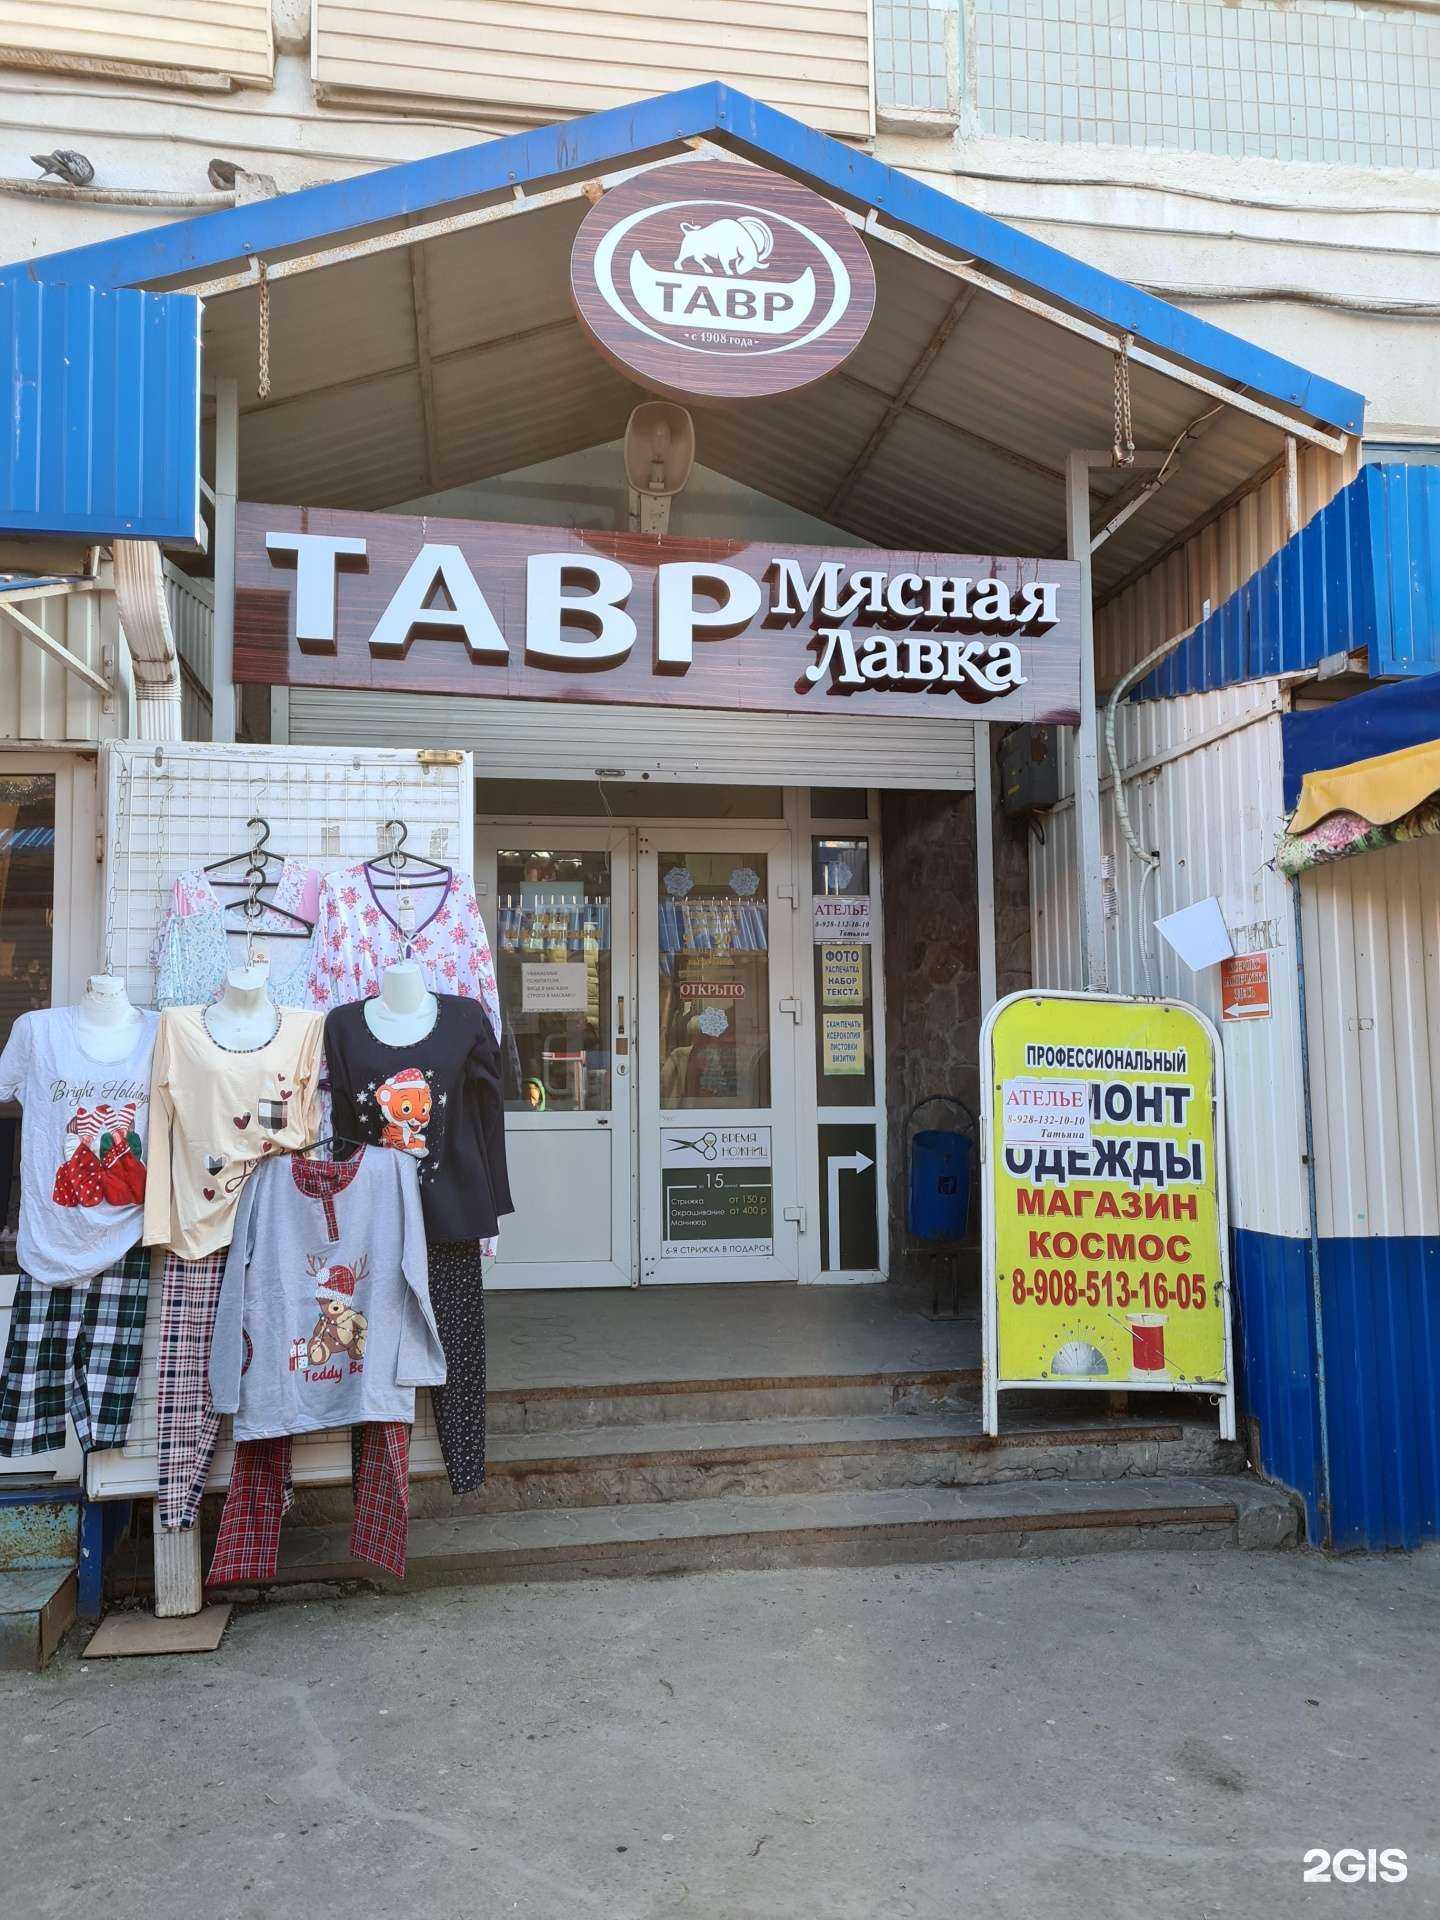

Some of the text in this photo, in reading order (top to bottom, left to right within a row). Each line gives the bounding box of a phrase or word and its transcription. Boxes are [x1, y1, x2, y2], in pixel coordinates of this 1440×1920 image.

[655, 281, 794, 321] ТАВР
[701, 332, 727, 344] 1908
[729, 336, 752, 347] года
[770, 558, 1060, 622] Мясная
[265, 531, 762, 675] ТАВР
[805, 628, 1028, 692] Лавка
[815, 904, 869, 916] АТЕЛЬЕ
[825, 950, 860, 962] ФОТО
[680, 983, 745, 996] ОТКРЫТО
[828, 977, 857, 985] НАБОР
[826, 988, 859, 996] ТЕКСТА
[1027, 1045, 1186, 1073] ПРОФЕССИОНАЛЬНЫЙ
[49, 1079, 95, 1106] Bright
[1007, 1089, 1084, 1108] АТЕЛЬЕ
[1088, 1083, 1190, 1124] ОНТ
[1007, 1114, 1085, 1126] 8-928-132-10-10
[721, 1132, 757, 1142] ВРЕМЯ
[1040, 1128, 1085, 1139] Татьяна
[1005, 1139, 1202, 1187] ОДЕЖДЫ
[706, 1173, 724, 1189] 15
[742, 1195, 758, 1204] 150
[1017, 1189, 1198, 1221] МАГАЗИН
[671, 1209, 725, 1218] Окрашивание
[742, 1207, 759, 1215] 400
[681, 1246, 720, 1254] СТРИЖКА
[730, 1243, 771, 1252] ПОДАРОК
[1029, 1230, 1192, 1263] КОСМОС
[1012, 1267, 1207, 1311] 8-908-513-16-05
[302, 1365, 343, 1384] Teddy
